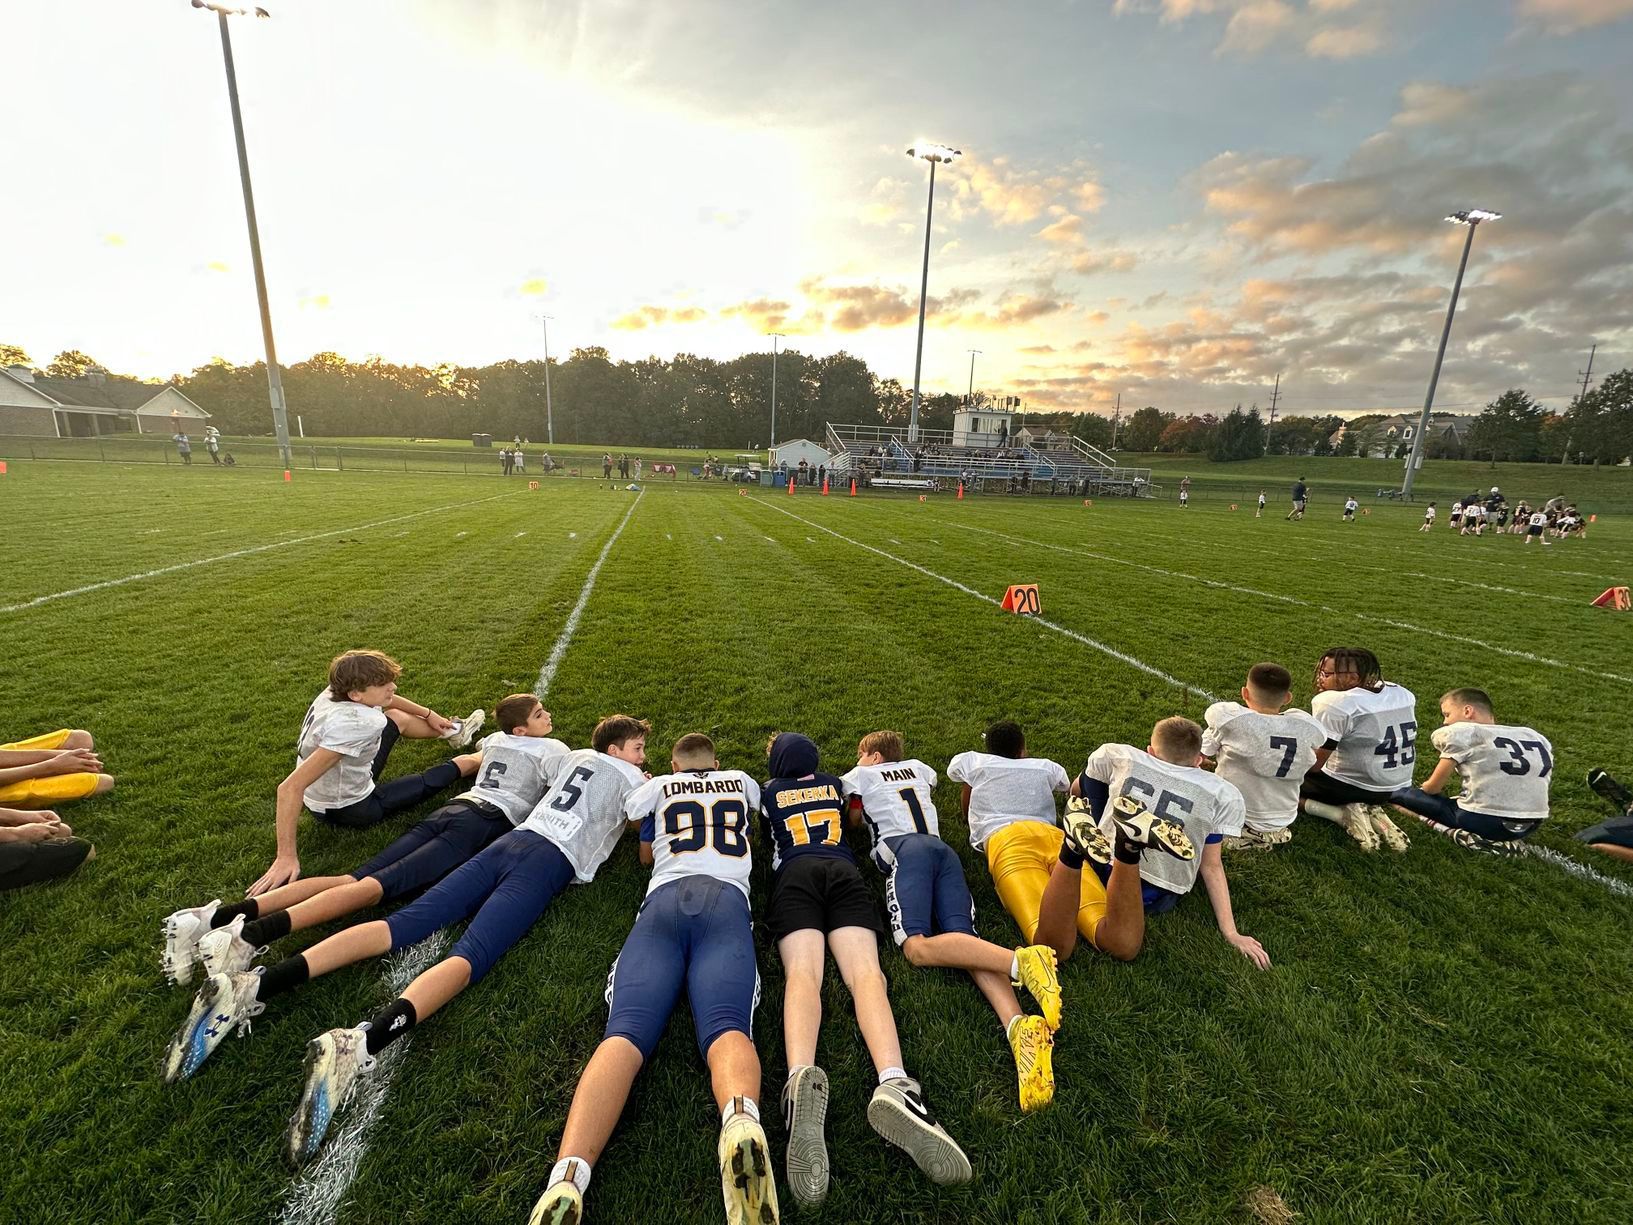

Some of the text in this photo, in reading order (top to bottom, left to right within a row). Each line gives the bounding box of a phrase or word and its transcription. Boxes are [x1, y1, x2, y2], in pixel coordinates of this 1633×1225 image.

[1014, 587, 1040, 614] 20
[1270, 735, 1298, 777] 7
[1374, 722, 1416, 769] 45
[1494, 736, 1553, 778] 37
[550, 766, 595, 813] 5
[663, 779, 744, 799] LOMBARDO
[881, 768, 917, 782] MAIN
[775, 784, 839, 809] SEKERKA
[896, 785, 930, 835] 1
[663, 799, 749, 858] 98
[783, 808, 843, 847] 17
